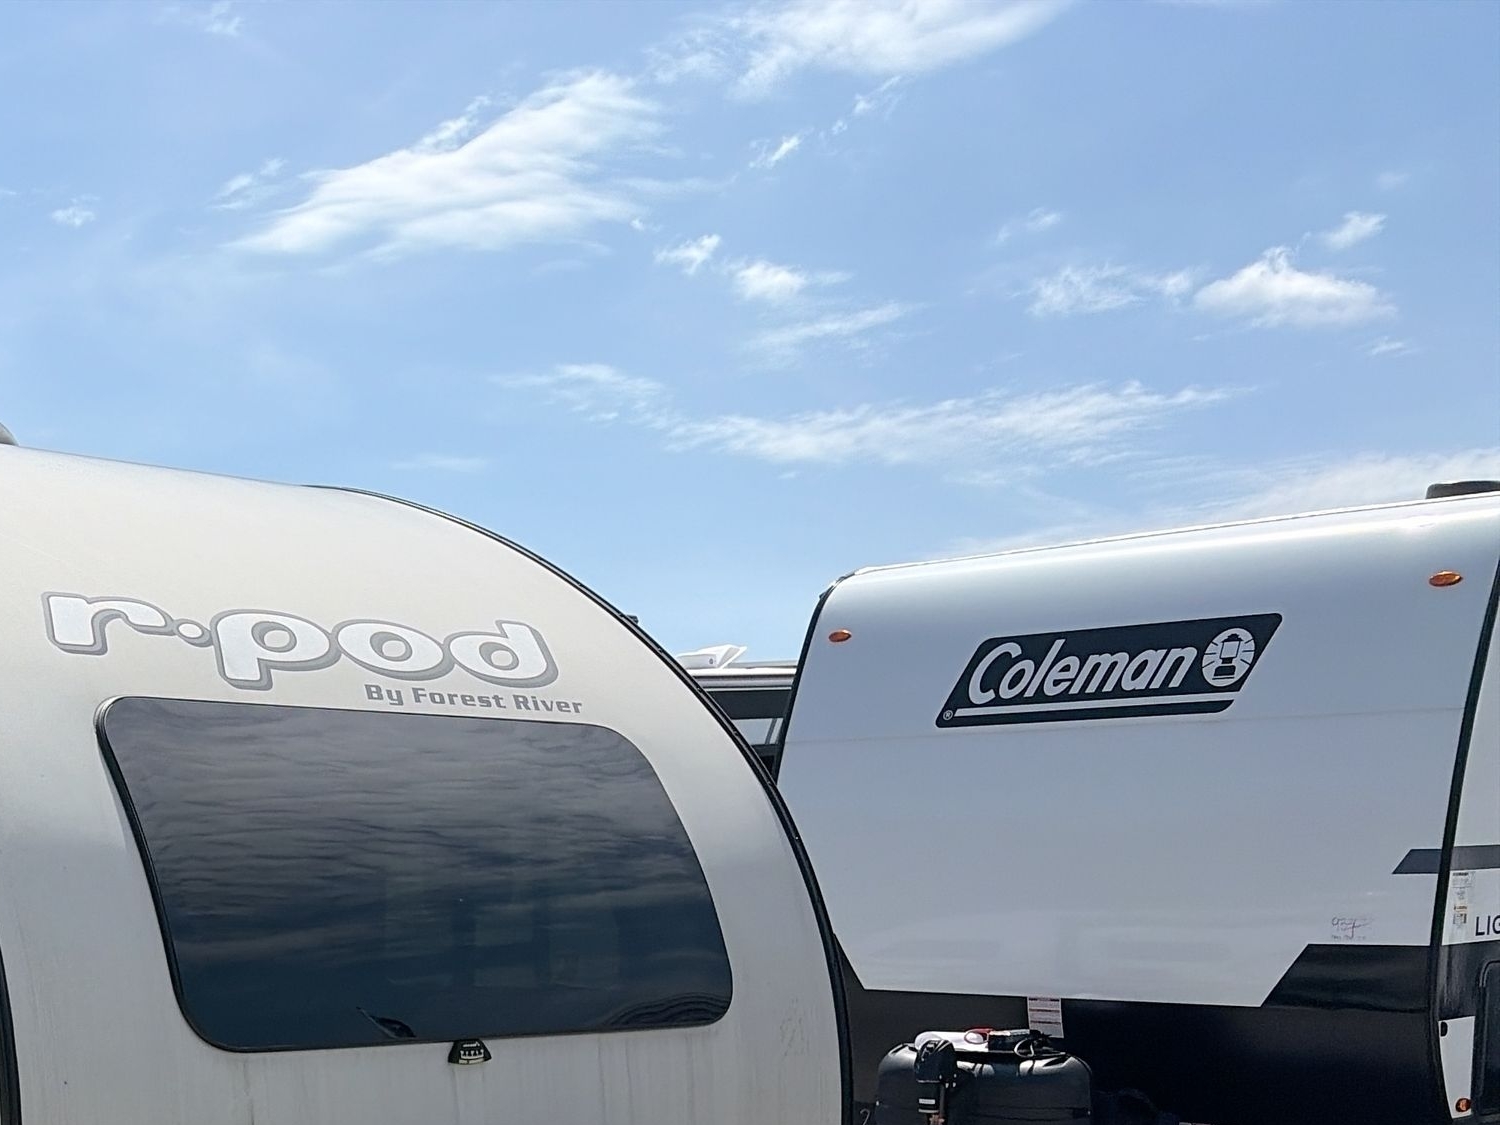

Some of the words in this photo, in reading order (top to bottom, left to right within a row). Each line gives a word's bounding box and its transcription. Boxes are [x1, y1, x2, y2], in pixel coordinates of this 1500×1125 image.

[968, 638, 1198, 705] Coleman
[364, 683, 404, 706] By
[411, 687, 506, 709] Forest
[513, 693, 583, 714] River
